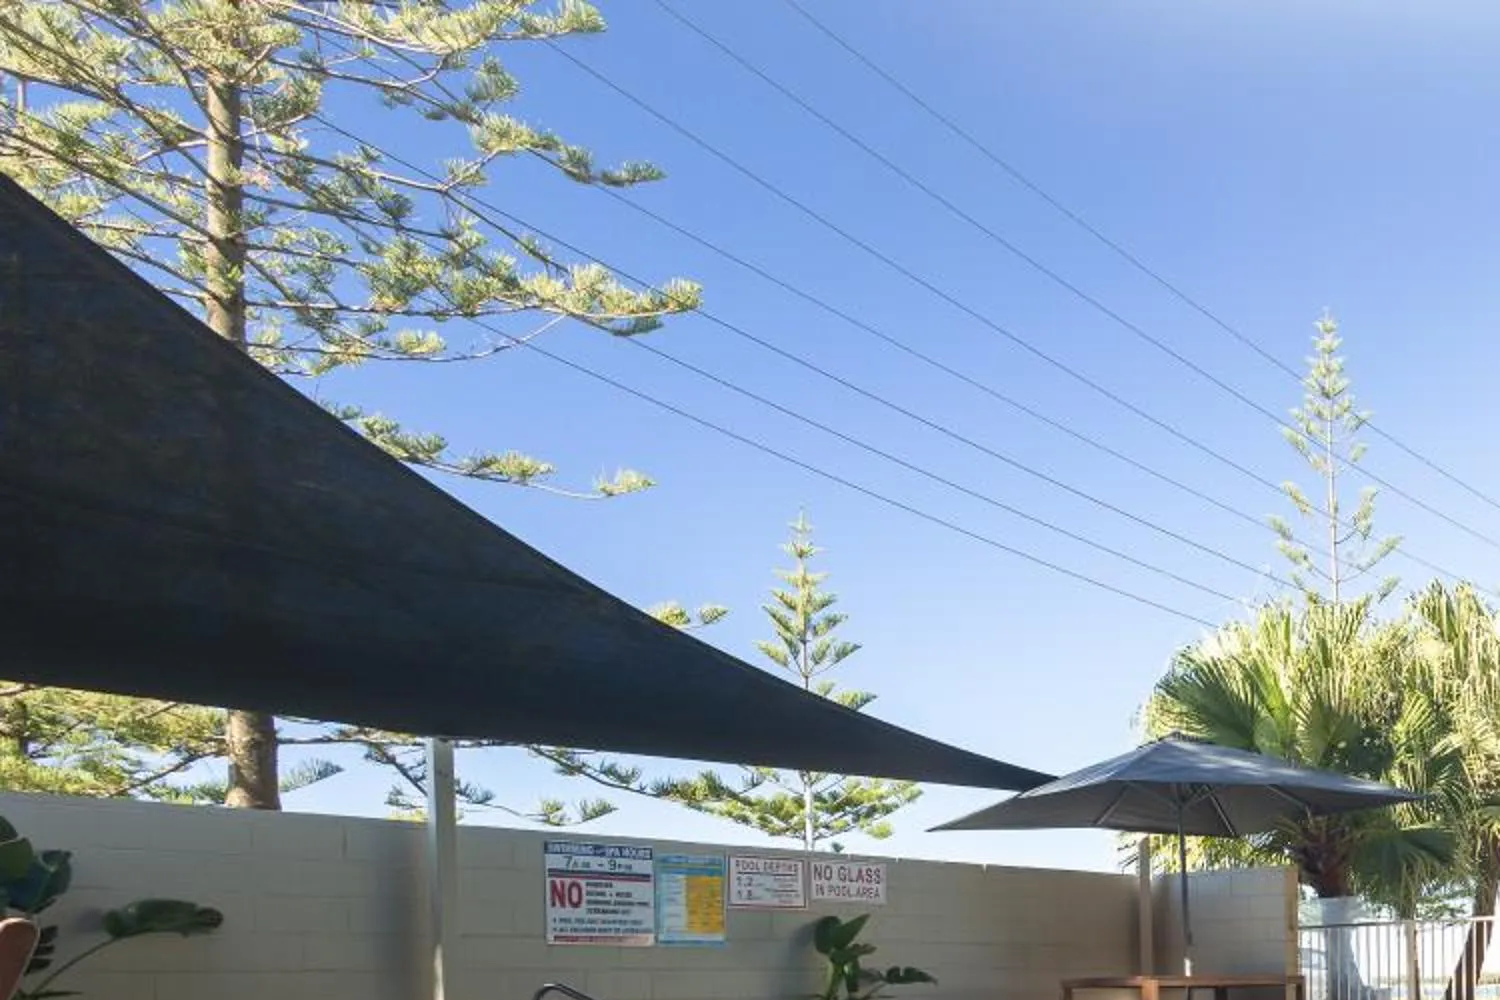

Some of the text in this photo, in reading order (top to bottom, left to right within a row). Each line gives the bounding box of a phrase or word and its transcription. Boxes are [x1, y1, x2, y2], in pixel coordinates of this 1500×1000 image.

[814, 864, 880, 884] NO GLASS
[551, 879, 582, 908] NO
[816, 884, 881, 898] IN POOL AREA
